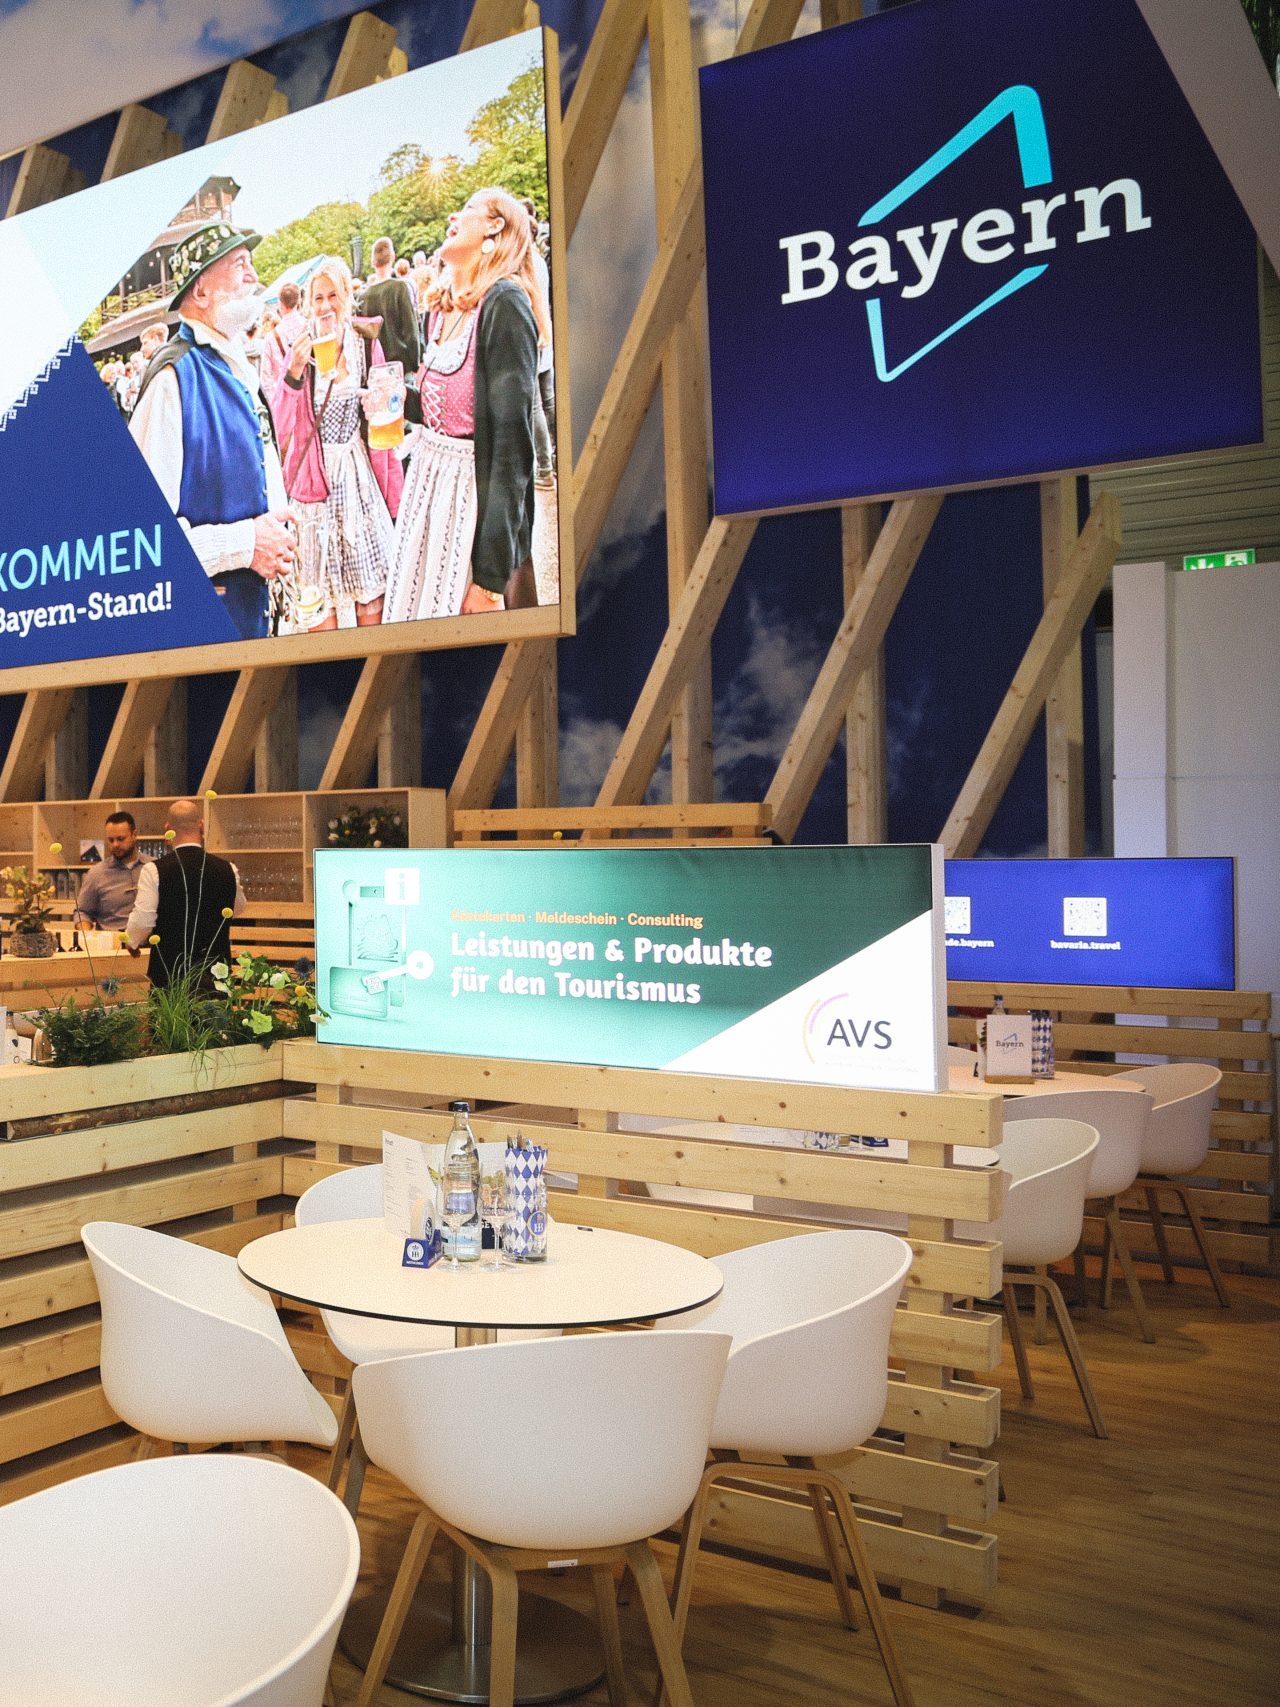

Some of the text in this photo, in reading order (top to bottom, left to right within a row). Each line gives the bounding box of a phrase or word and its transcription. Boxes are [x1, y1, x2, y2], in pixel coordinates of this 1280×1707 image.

[778, 178, 1152, 305] Bayern
[535, 911, 617, 925] Meldeschein
[627, 912, 704, 929] Consulting
[451, 931, 772, 967] Leistungen & Produkte
[944, 938, 1122, 950] de.bayern bavaria.travel
[450, 967, 702, 1004] für den Tourismus
[826, 1018, 893, 1050] AVS
[995, 1040, 1024, 1048] Bayern
